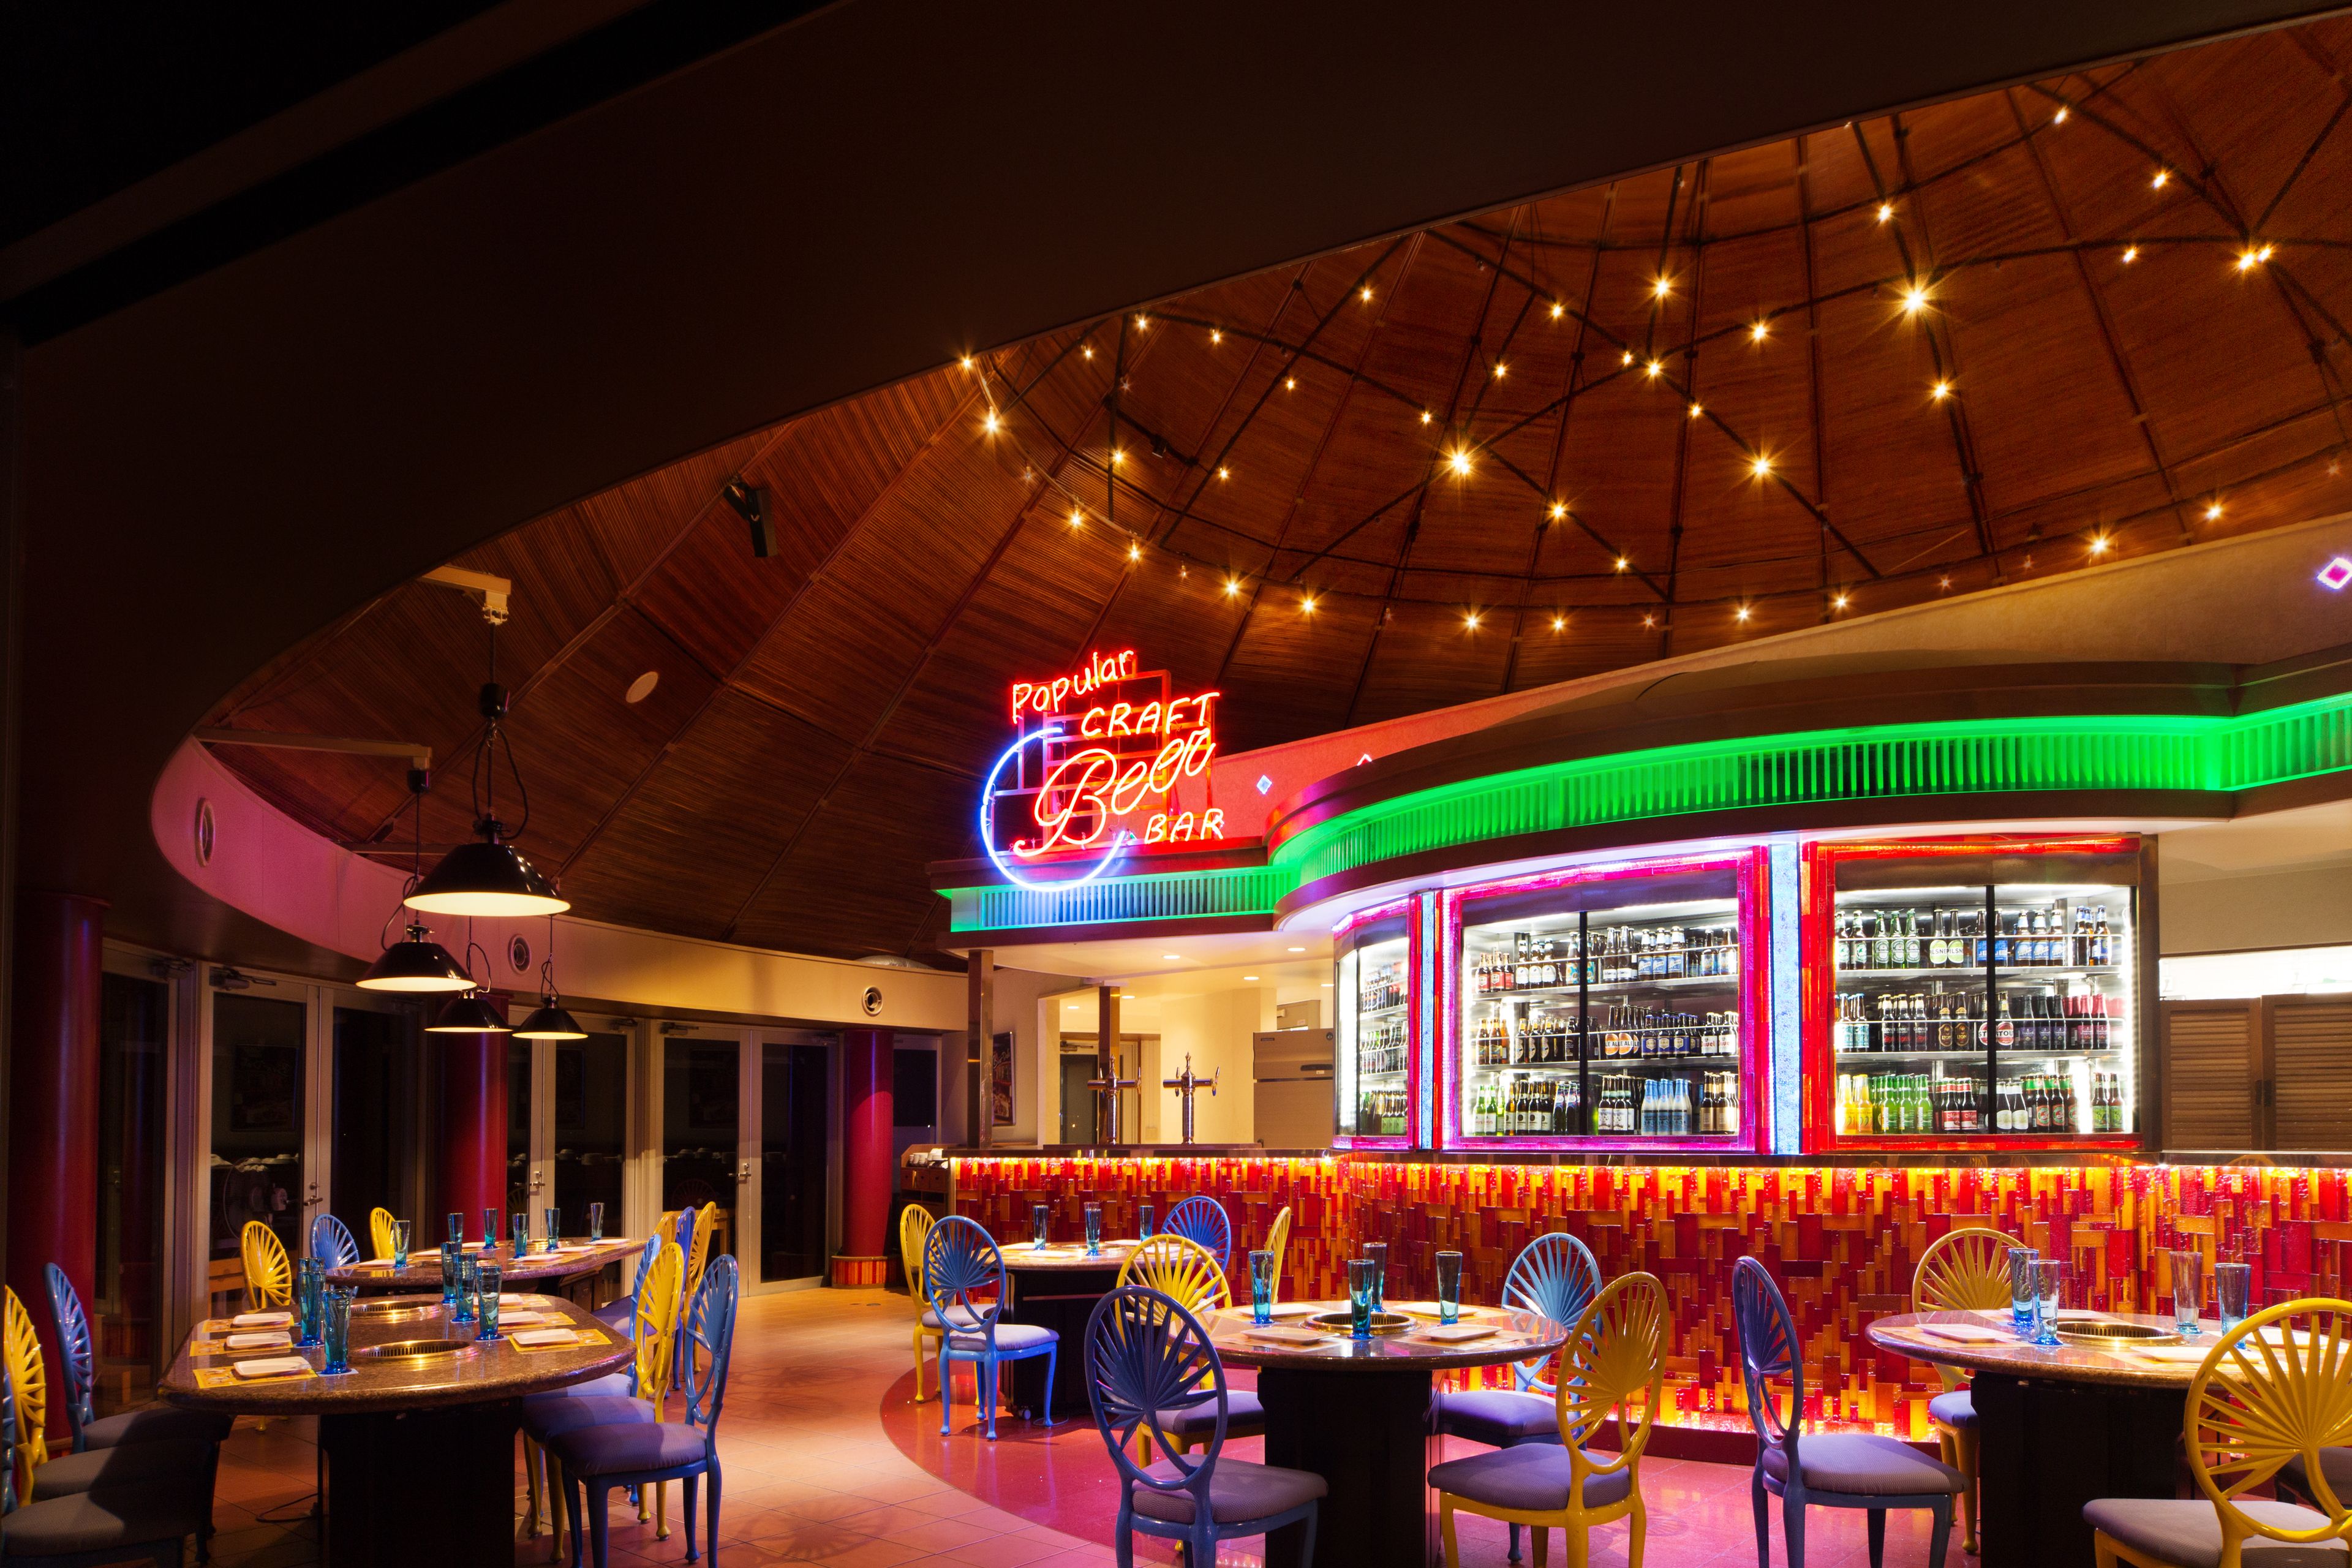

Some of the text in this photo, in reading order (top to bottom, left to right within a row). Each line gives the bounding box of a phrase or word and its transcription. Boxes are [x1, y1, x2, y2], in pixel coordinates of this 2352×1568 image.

[1012, 650, 1134, 725] Popular
[1080, 692, 1221, 737] CRAFT
[1012, 728, 1216, 857] Beer
[1144, 808, 1224, 845] BAR
